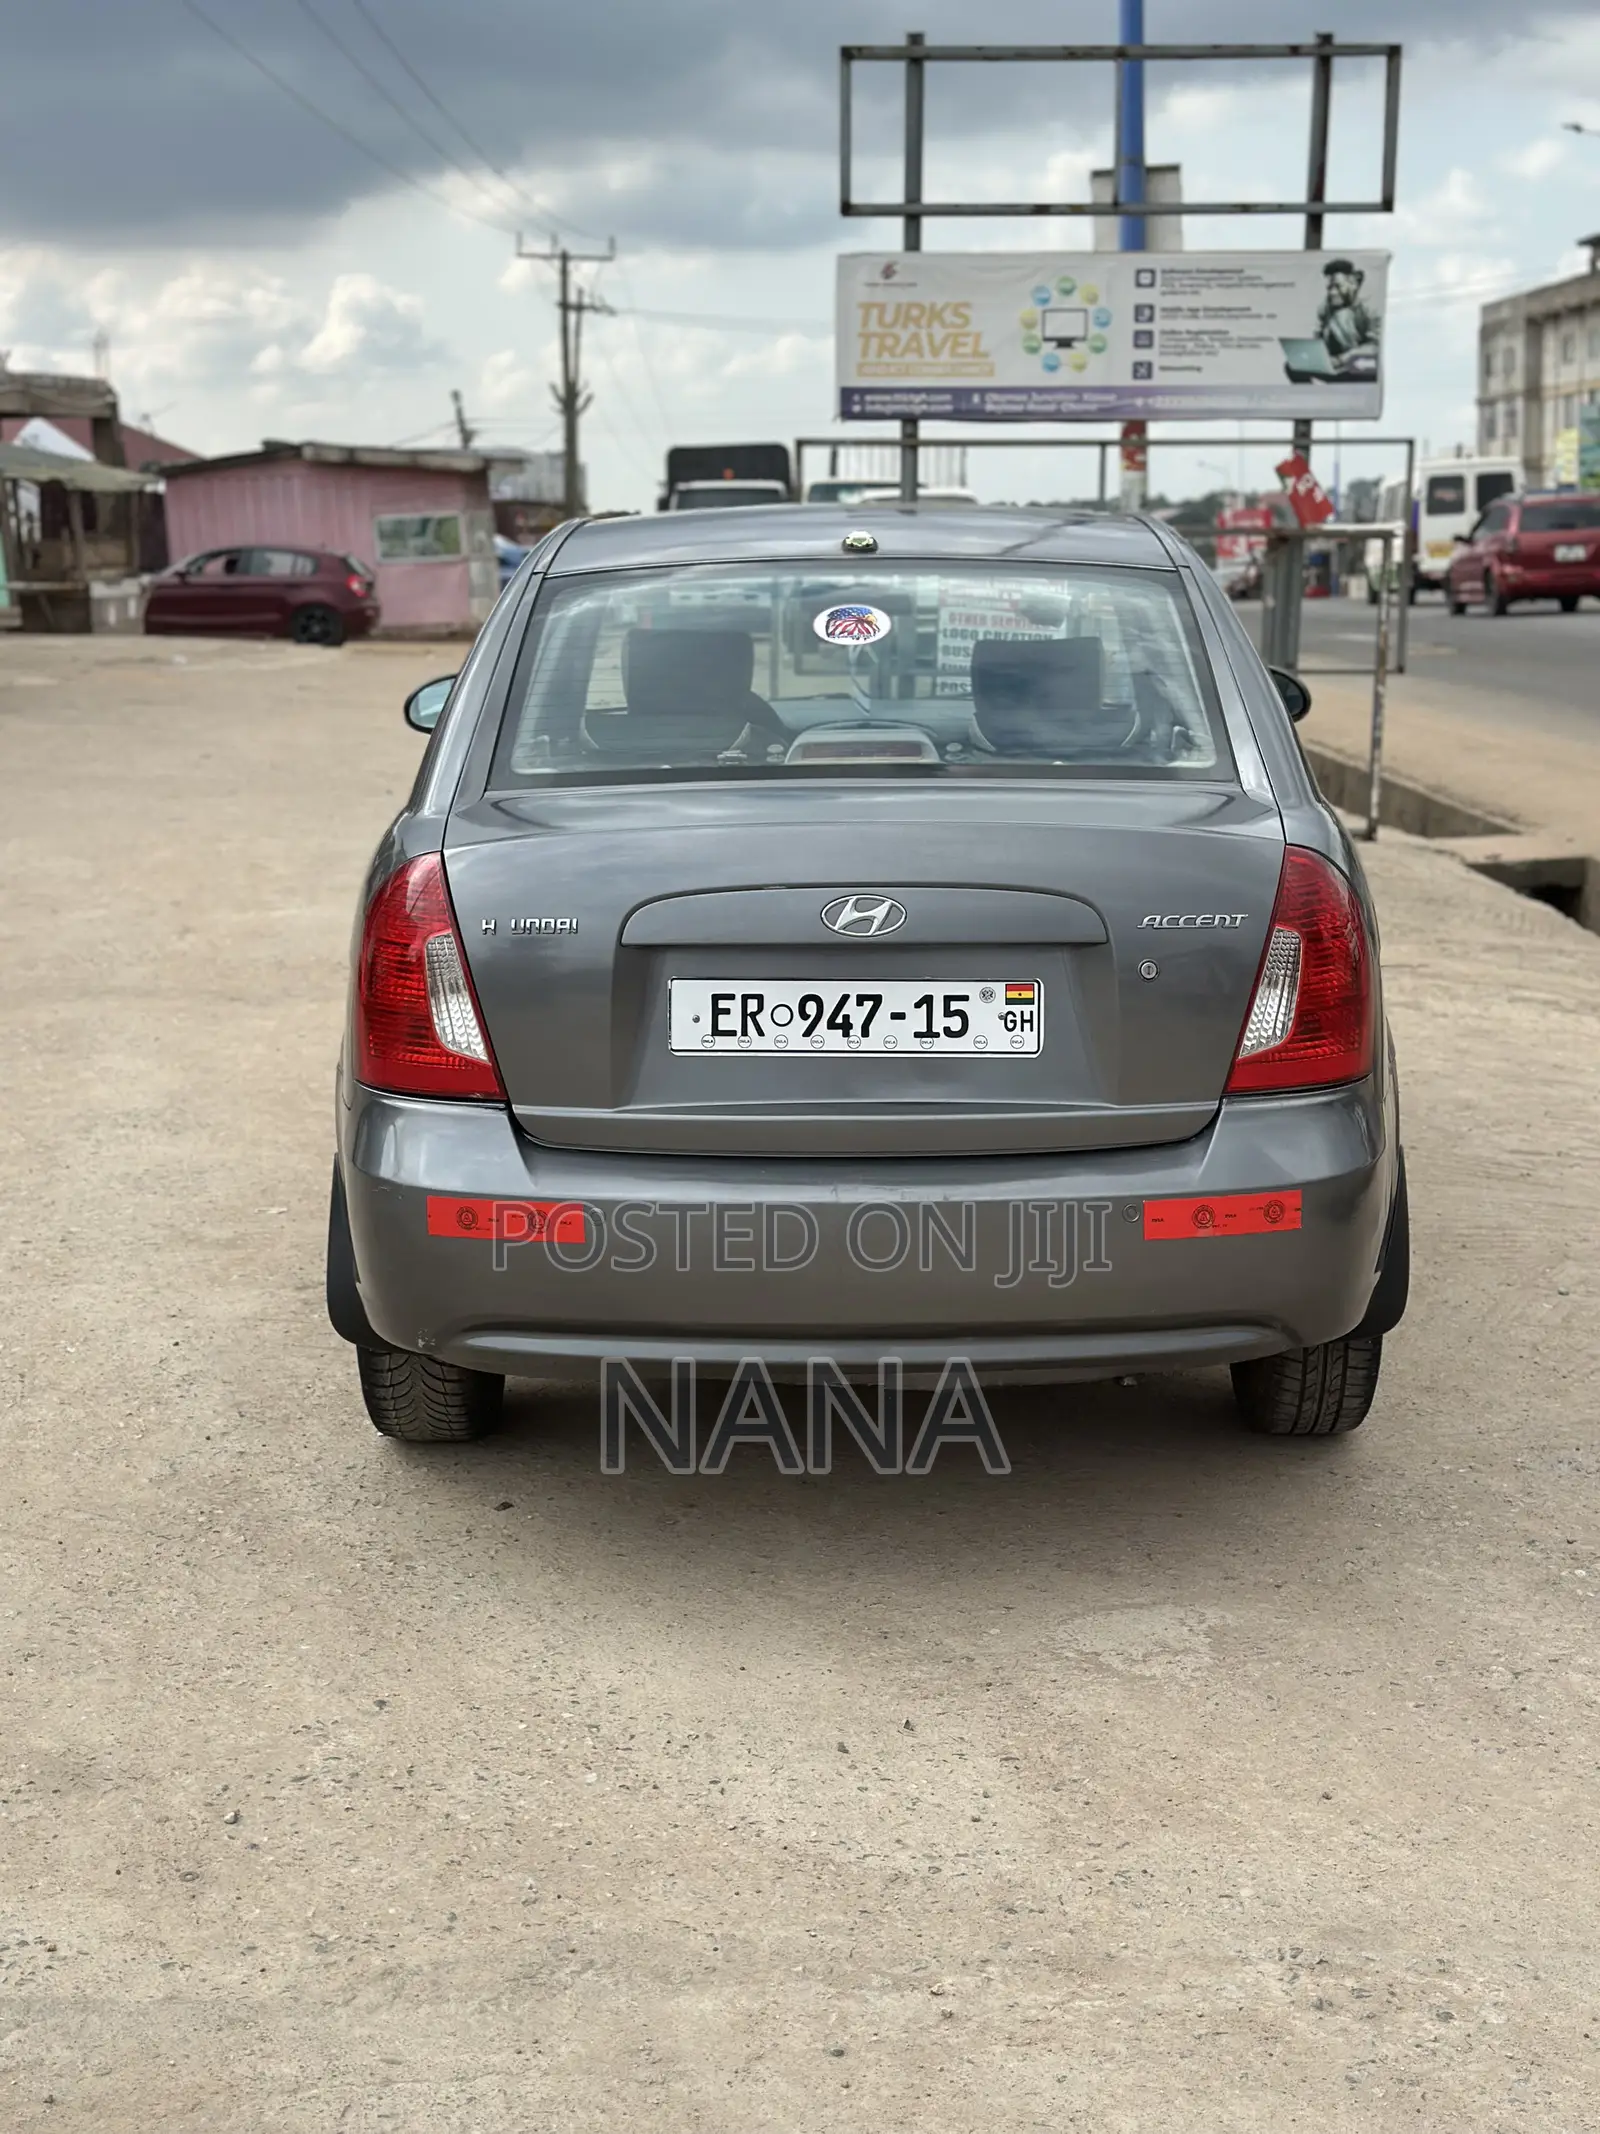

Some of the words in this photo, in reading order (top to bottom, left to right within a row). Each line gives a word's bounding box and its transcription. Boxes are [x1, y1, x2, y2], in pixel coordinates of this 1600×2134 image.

[857, 302, 973, 330] TURKS
[857, 332, 991, 358] TRAVEL
[942, 628, 979, 640] LOGO
[1137, 913, 1249, 929] ACCENT
[798, 993, 969, 1038] 947-15
[1003, 1010, 1034, 1032] GH
